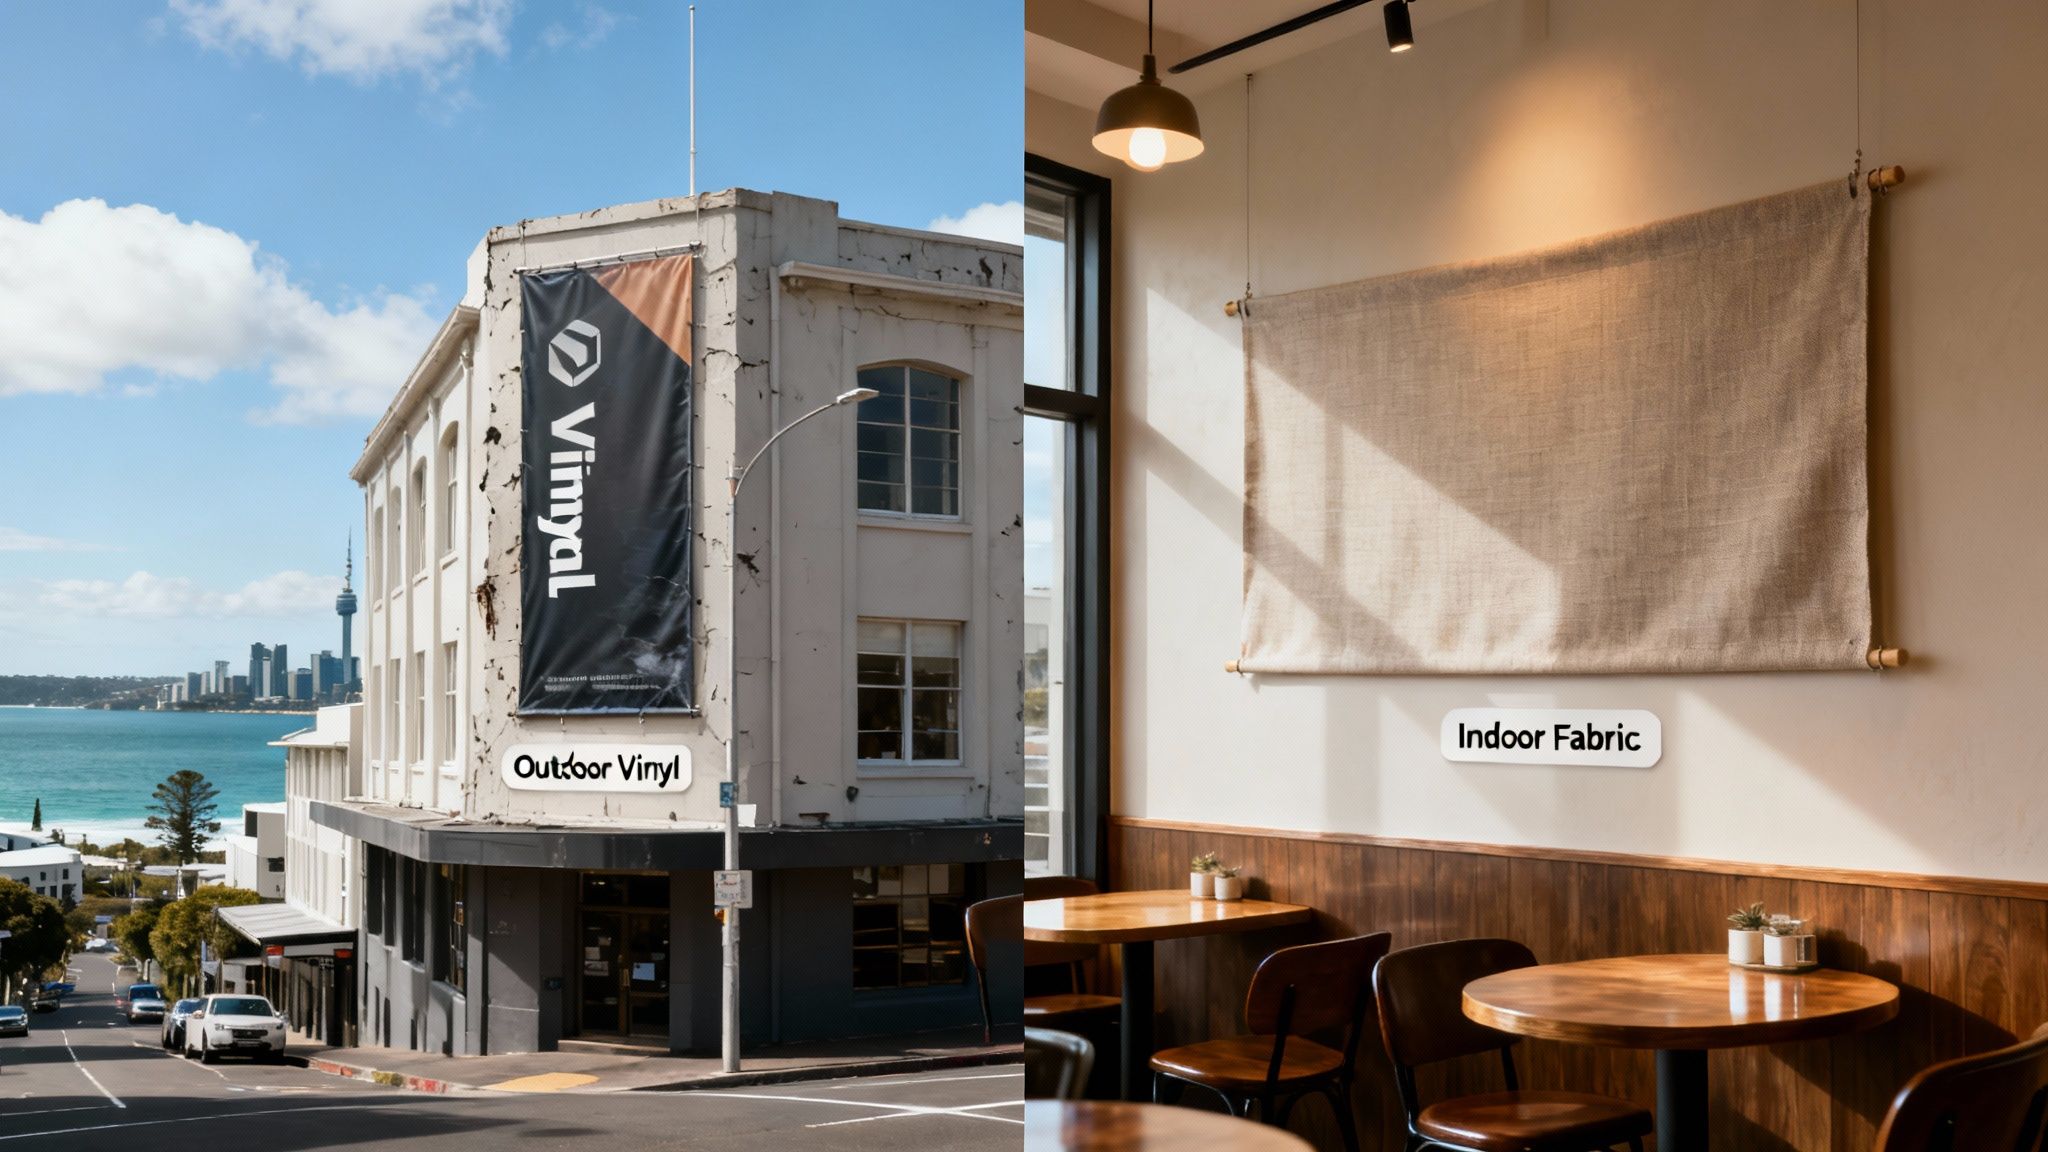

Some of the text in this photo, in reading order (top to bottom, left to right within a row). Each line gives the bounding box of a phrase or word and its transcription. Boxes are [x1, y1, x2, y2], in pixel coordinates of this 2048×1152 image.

[1458, 720, 1642, 752] Indoor Fabric
[513, 751, 680, 788] Outdoor Vinyl
